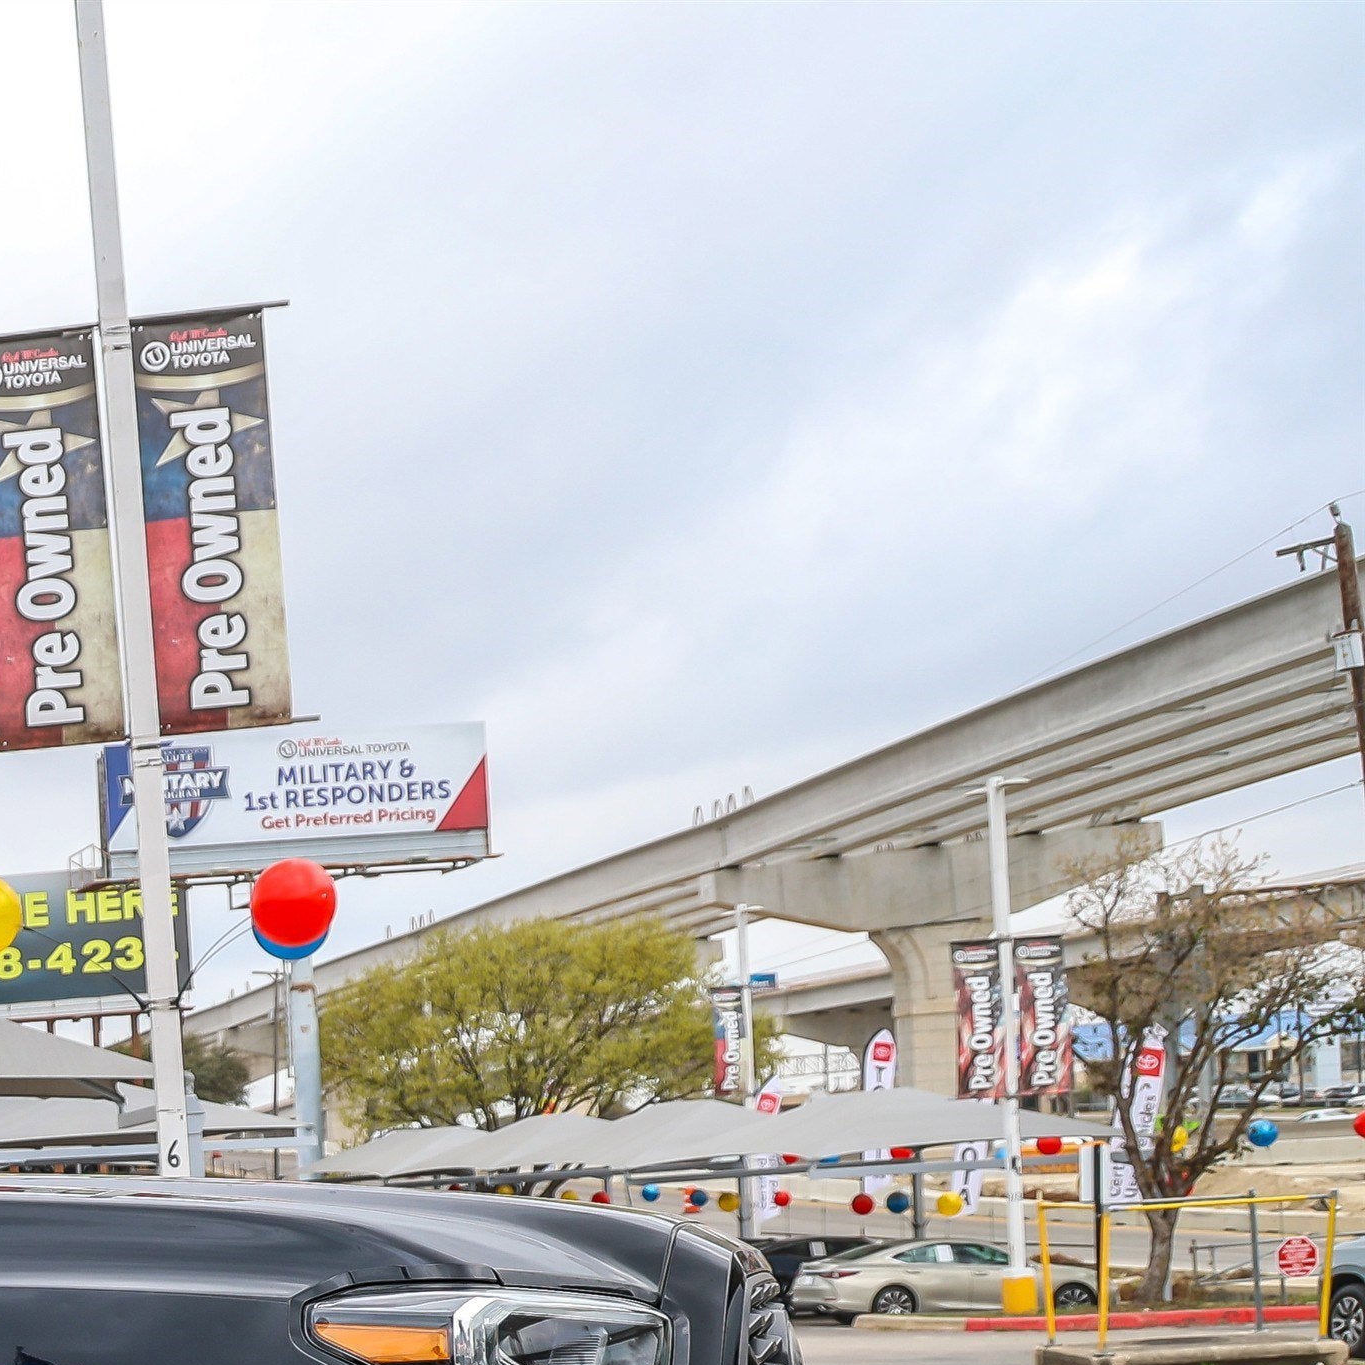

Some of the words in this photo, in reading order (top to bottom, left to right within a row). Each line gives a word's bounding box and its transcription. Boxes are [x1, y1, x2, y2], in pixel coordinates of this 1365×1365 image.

[170, 333, 256, 354] UNIVERSAL
[172, 350, 230, 369] TOYOTA
[3, 354, 87, 375] UNIVERSAL
[4, 370, 62, 389] TOYOTA
[169, 406, 244, 604] Owned
[1, 427, 77, 622] Owned
[189, 613, 250, 711] Pre
[25, 631, 85, 728] Pre
[299, 743, 365, 758] UNIVERSAL
[367, 741, 411, 754] TOYOTA
[278, 759, 393, 786] MILITARY
[399, 758, 416, 778] &
[244, 791, 279, 812] 1st
[285, 780, 452, 809] RESPONDERS
[261, 814, 291, 830] Get
[295, 809, 373, 828] Preferred
[378, 806, 437, 824] Pricing
[965, 975, 994, 1051] Owned
[1027, 972, 1057, 1047] Owned
[968, 1053, 994, 1090] Pre
[1031, 1049, 1057, 1086] Pre
[168, 1139, 180, 1168] 6
